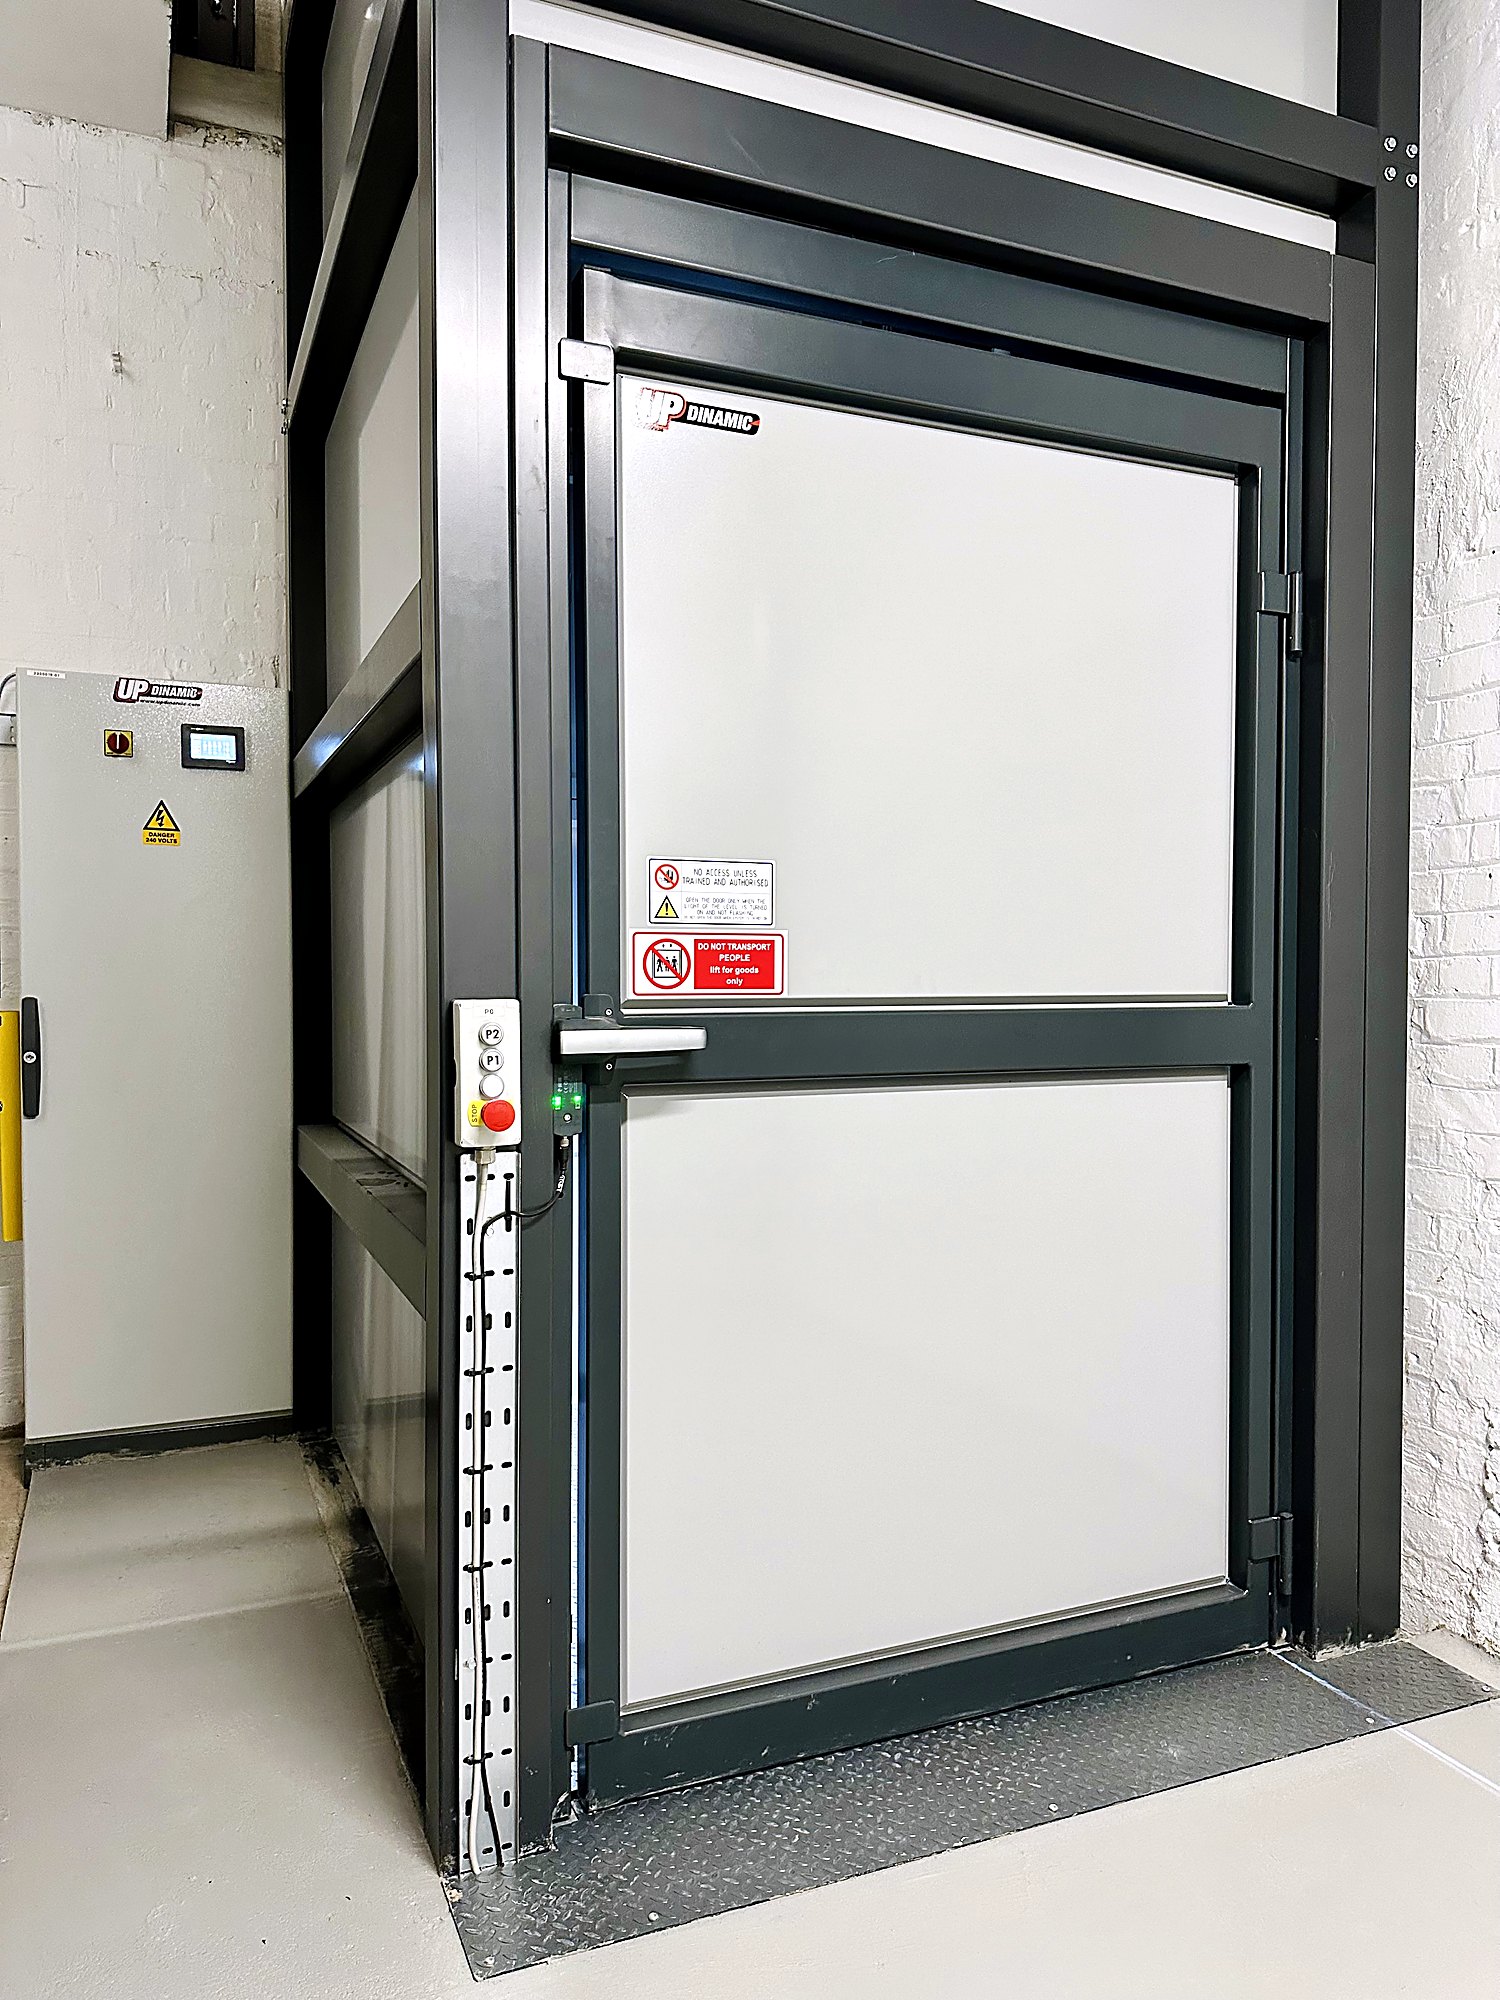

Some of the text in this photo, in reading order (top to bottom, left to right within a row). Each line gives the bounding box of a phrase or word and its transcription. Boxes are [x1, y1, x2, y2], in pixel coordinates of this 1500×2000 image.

[686, 404, 754, 432] DINAMIC
[114, 677, 198, 702] UP DINAMIC
[693, 868, 758, 878] NO ACCESS UNLESS
[682, 876, 769, 887] TRAINED AND AUTHORISED
[697, 942, 771, 951] DO NOT TRANSPORT
[719, 953, 751, 962] PEOPLE
[709, 965, 759, 976] lift for goods
[725, 977, 744, 987] only
[485, 1029, 500, 1040] P2
[487, 1055, 500, 1066] P1
